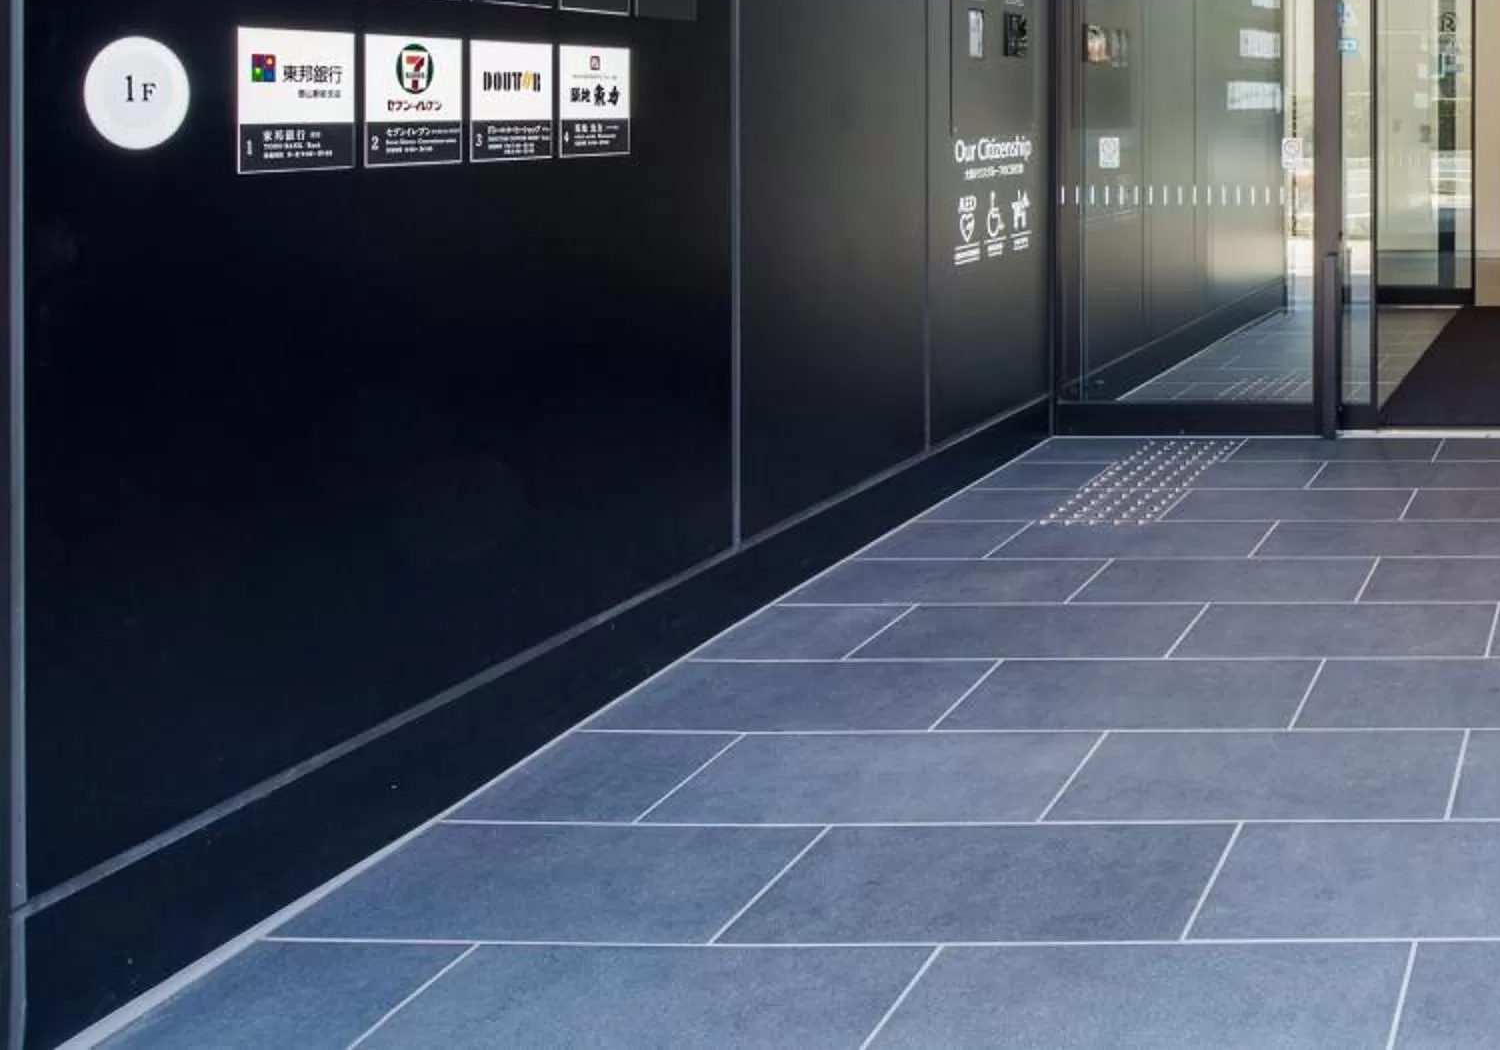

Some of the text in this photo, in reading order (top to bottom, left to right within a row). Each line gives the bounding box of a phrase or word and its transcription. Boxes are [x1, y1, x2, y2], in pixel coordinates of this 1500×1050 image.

[282, 64, 343, 85] 東邦銀行
[483, 70, 541, 92] DOUTOR
[125, 76, 157, 103] 1F
[371, 135, 379, 151] 2
[475, 133, 483, 147] 3
[564, 131, 569, 144] 4
[955, 139, 976, 163] Our
